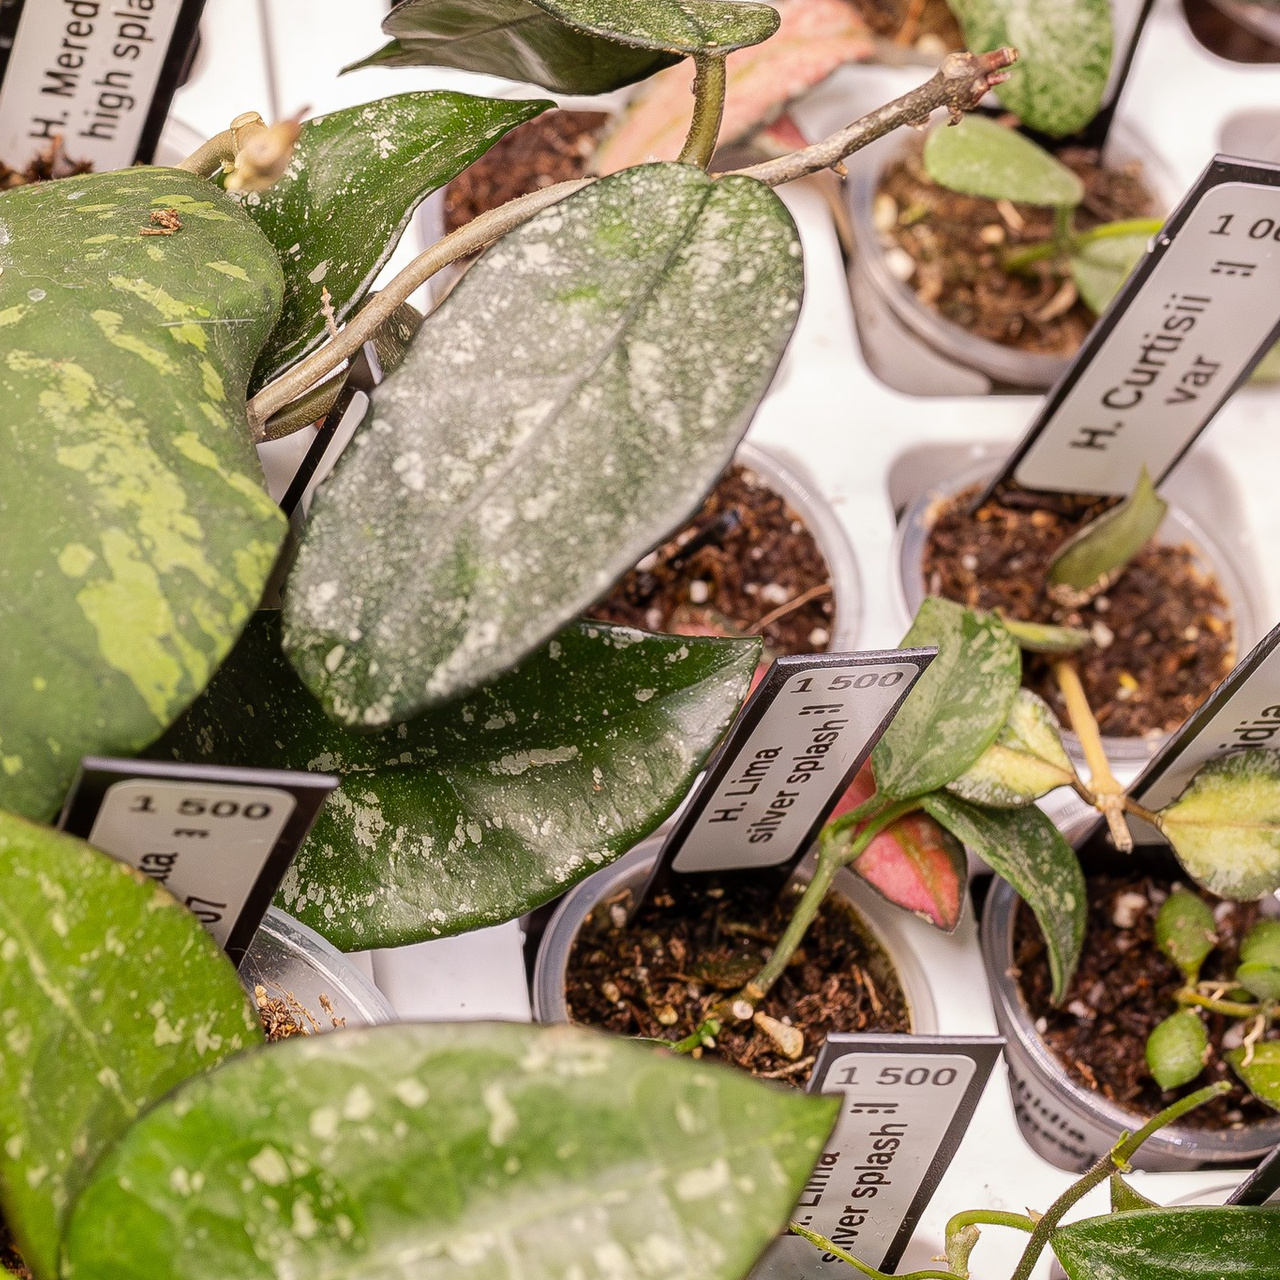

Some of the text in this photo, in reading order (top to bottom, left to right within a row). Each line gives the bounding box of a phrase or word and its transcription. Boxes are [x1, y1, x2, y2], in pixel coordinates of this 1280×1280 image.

[29, 110, 69, 140] H.
[79, 69, 135, 139] high
[1208, 213, 1236, 236] 1
[1069, 293, 1212, 451] H. Curtisii
[1164, 353, 1222, 406] var
[789, 671, 904, 694] 1 500
[128, 794, 272, 820] 1 500
[708, 746, 784, 824] H. Lima
[746, 718, 850, 844] silver splash
[836, 1067, 958, 1086] 1 500
[851, 1123, 909, 1199] splash
